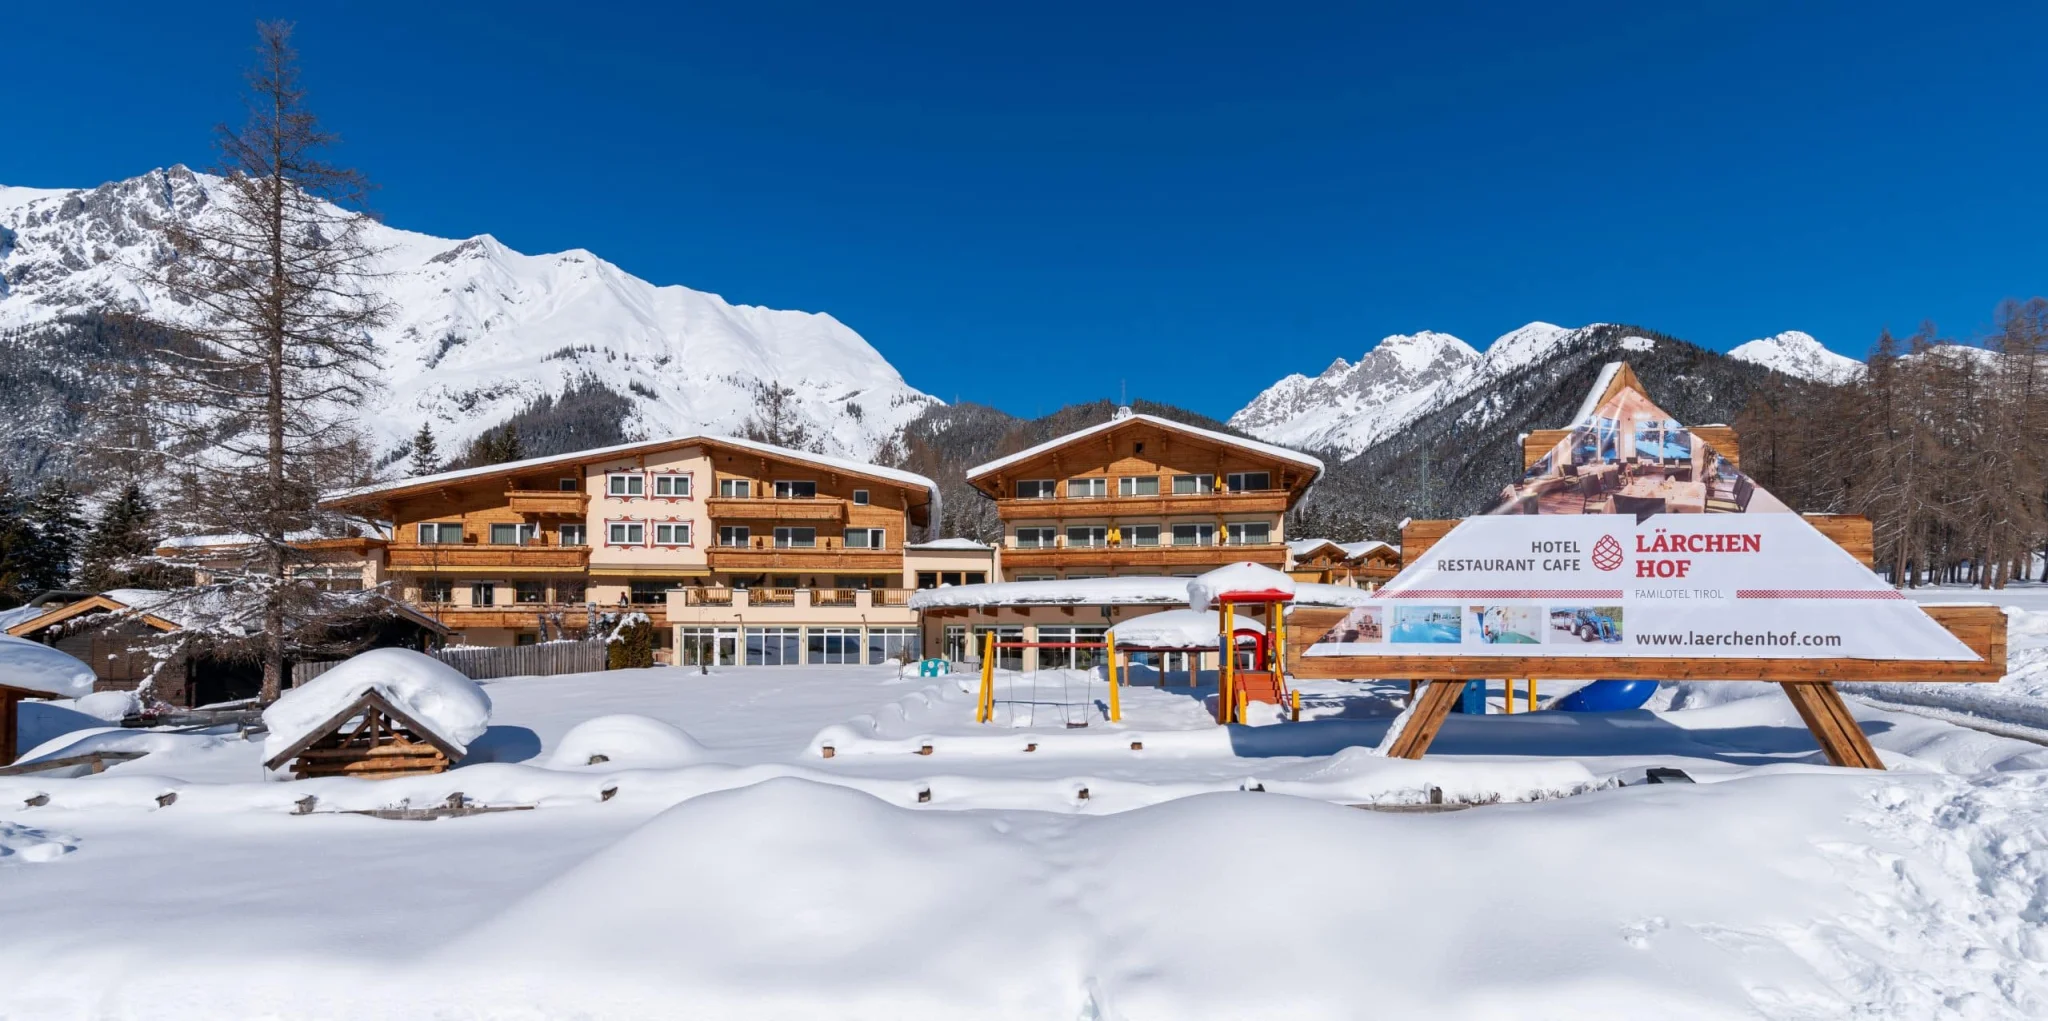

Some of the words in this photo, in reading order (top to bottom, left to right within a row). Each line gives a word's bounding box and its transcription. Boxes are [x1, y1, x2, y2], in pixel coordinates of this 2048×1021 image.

[1531, 540, 1581, 554] HOTEL
[1635, 528, 1762, 553] LÄRCHEN
[1437, 558, 1536, 572] RESTAURANT
[1542, 558, 1581, 572] CAFE
[1635, 559, 1692, 579] HOF
[1634, 588, 1690, 600] FAMILOTEL
[1693, 588, 1724, 600] TIROL
[1635, 630, 1842, 647] www.laerchenhof.com
